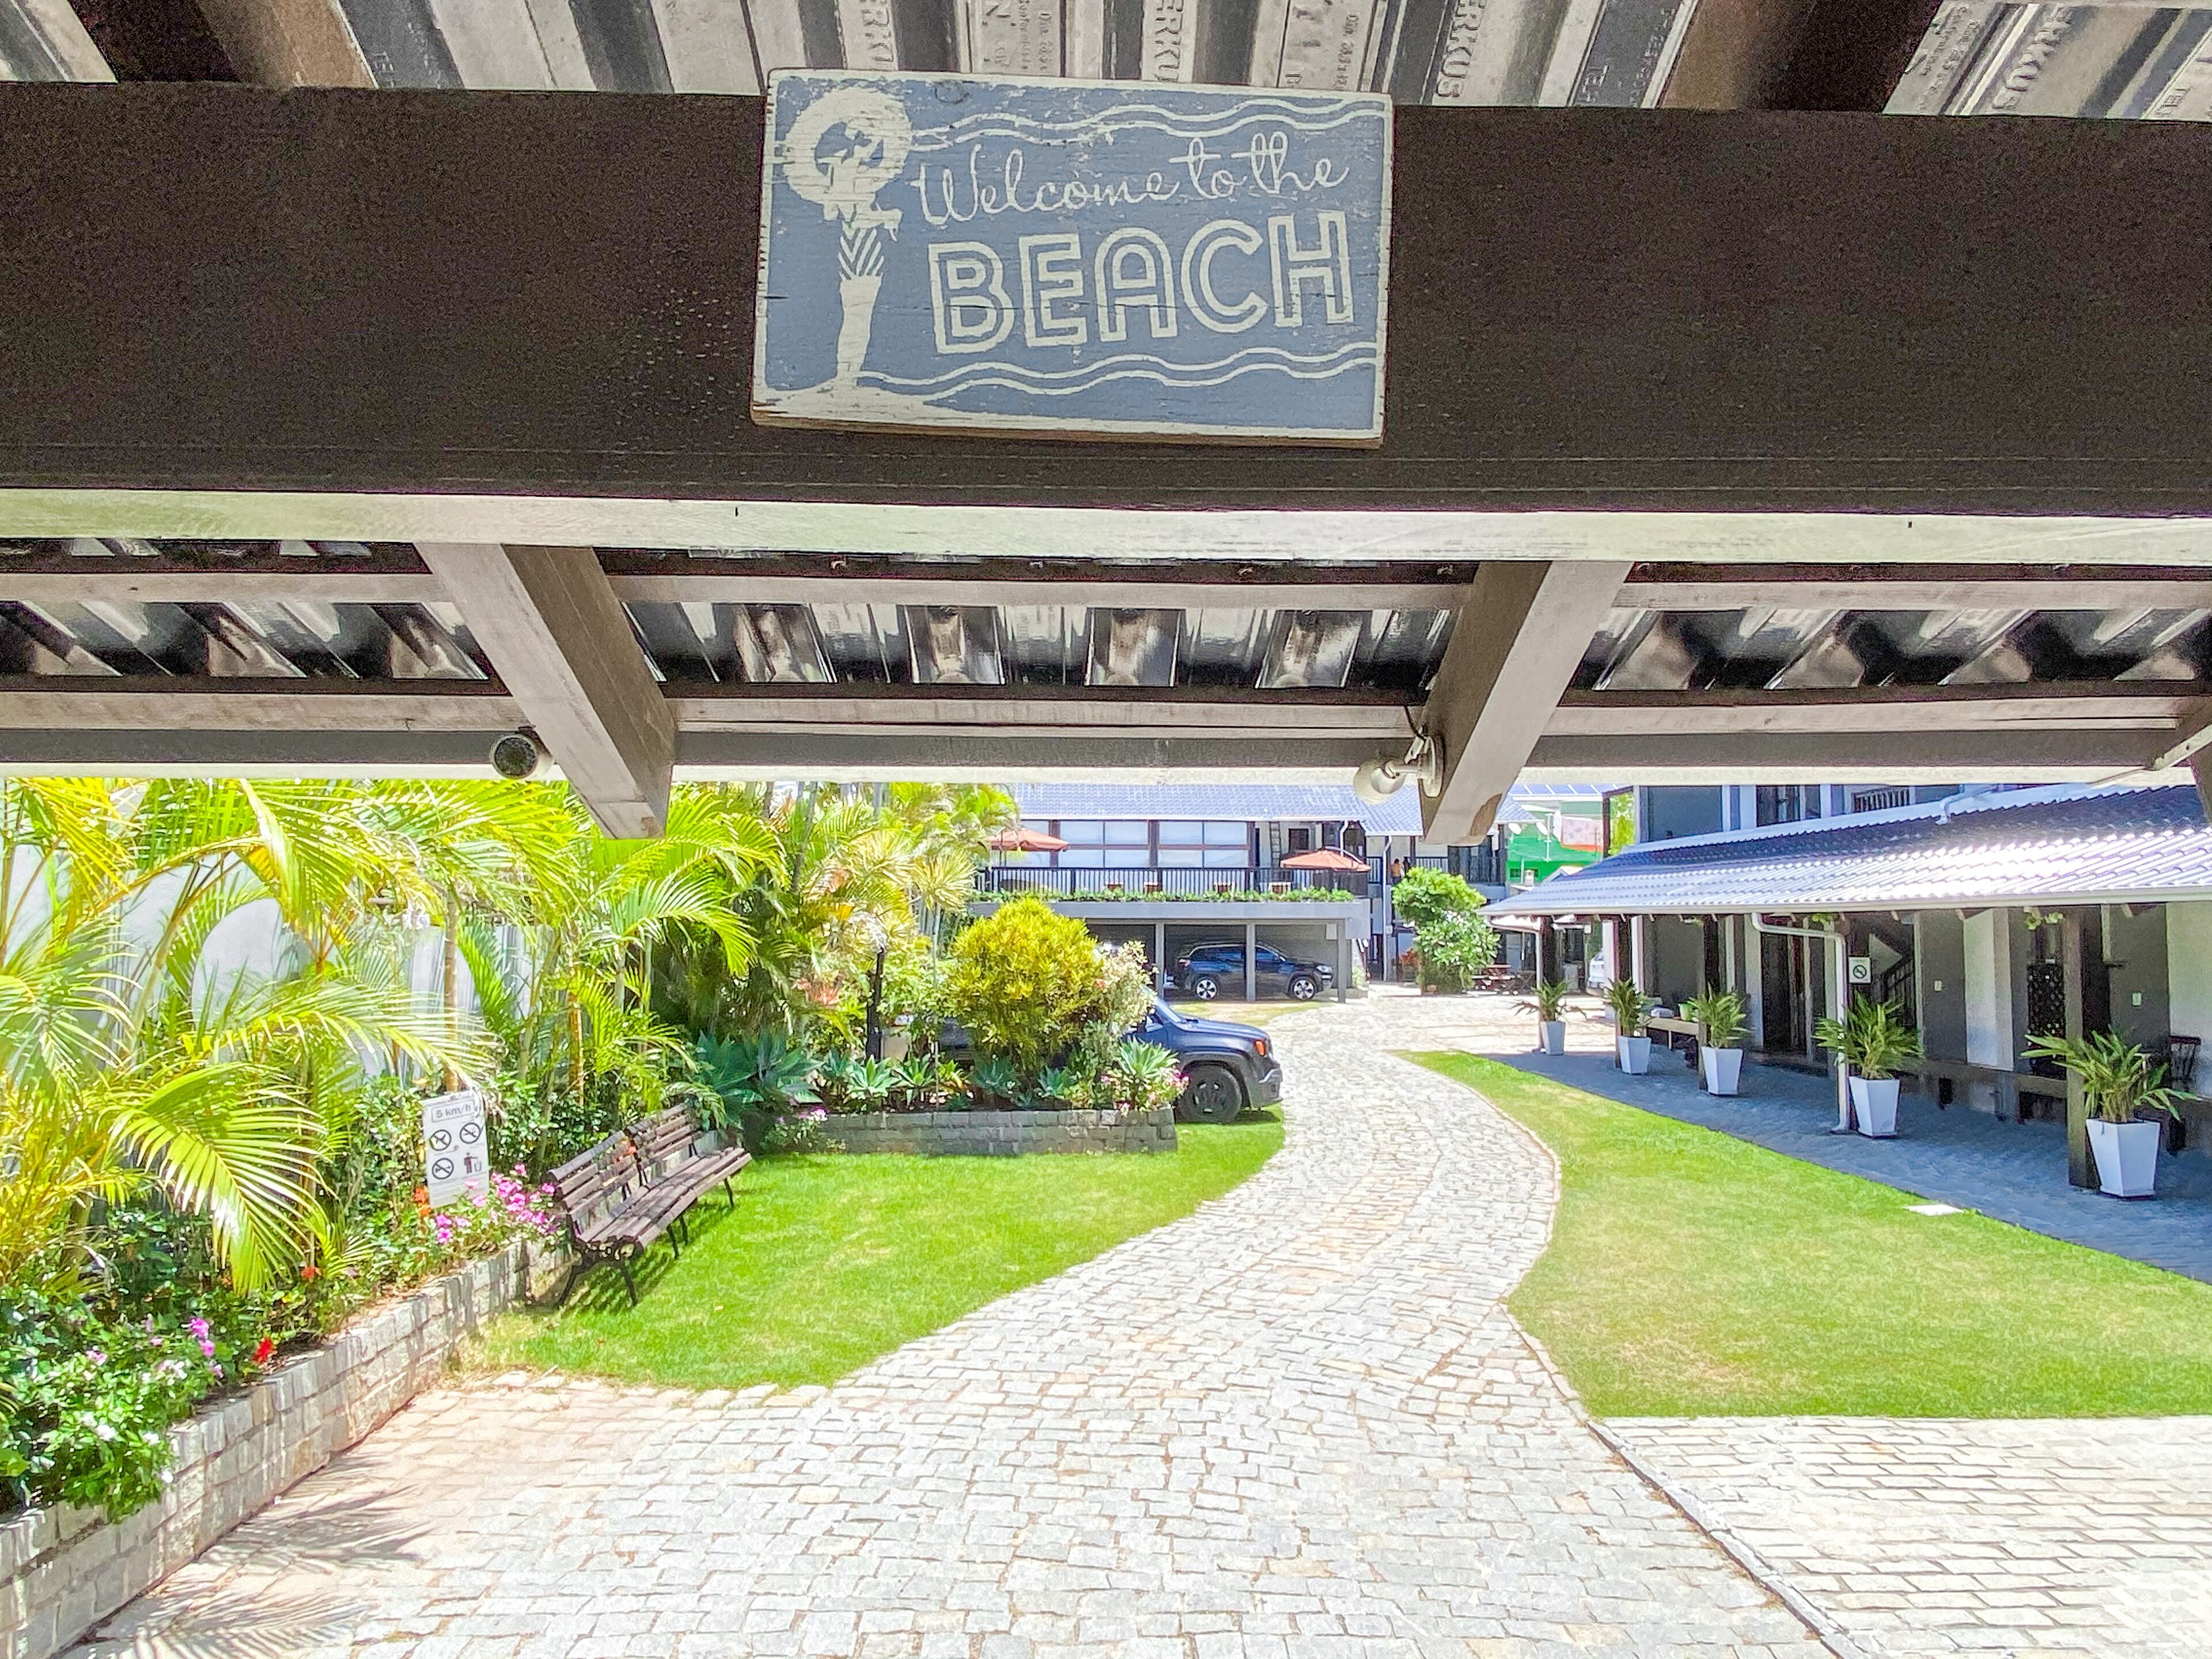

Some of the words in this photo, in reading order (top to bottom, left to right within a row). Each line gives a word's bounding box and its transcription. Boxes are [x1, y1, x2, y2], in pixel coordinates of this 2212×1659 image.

[910, 143, 1180, 225] Welcome
[1168, 137, 1247, 199] to
[1231, 131, 1350, 195] the
[927, 210, 1354, 354] BEACH
[436, 1109, 443, 1118] 5
[445, 1104, 471, 1116] km/h
